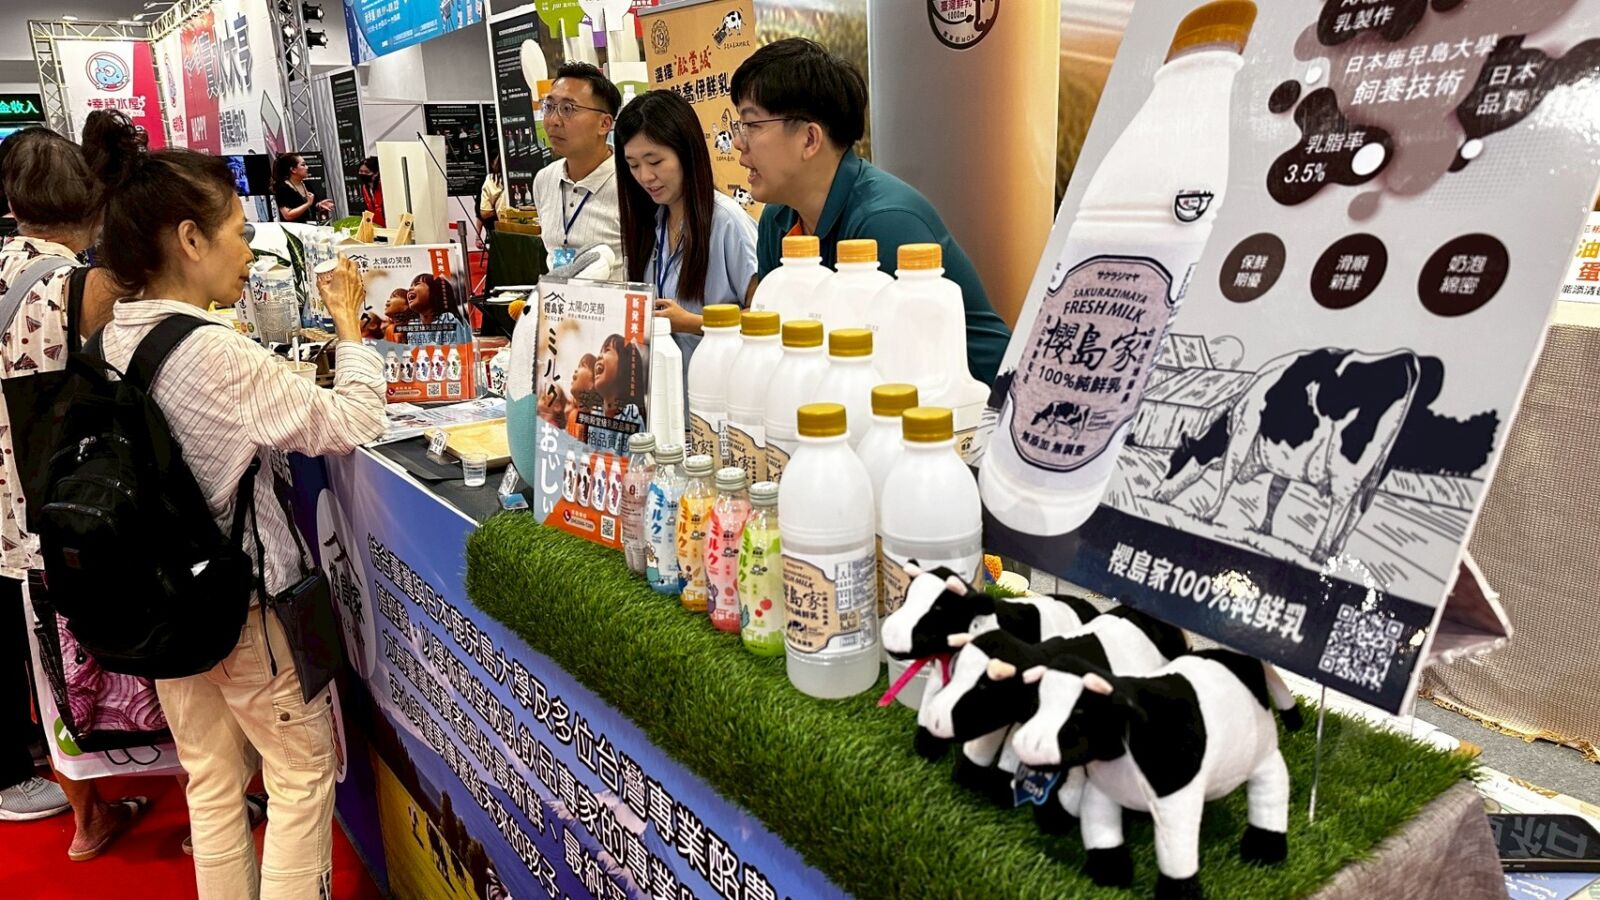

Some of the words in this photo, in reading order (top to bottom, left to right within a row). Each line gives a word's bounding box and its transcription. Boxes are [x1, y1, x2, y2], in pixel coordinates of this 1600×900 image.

[1333, 6, 1395, 33] 乳製作
[1345, 34, 1498, 74] 日本鹿兒島大學
[1490, 63, 1539, 86] 日本
[1351, 70, 1466, 105] 飼養技術
[1476, 93, 1529, 115] 品質
[1305, 131, 1366, 154] 乳脂率
[1284, 163, 1326, 184] 3.5%
[1241, 255, 1268, 271] 保鮮
[1336, 255, 1369, 271] 滑順
[1447, 255, 1487, 273] 奶泡
[1098, 271, 1140, 282] サクラジマヤ
[1328, 273, 1363, 290] 新鮮
[1439, 276, 1480, 295] 綿密
[1073, 287, 1148, 304] SAKURAZIMAYA
[1063, 300, 1107, 315] FRESH
[1106, 301, 1147, 323] MILK
[1044, 316, 1147, 372] 櫻島家
[1039, 365, 1121, 394] 100%純鮮乳
[651, 491, 665, 534] ミルク
[678, 505, 689, 548] ミルク
[707, 519, 720, 566] ミルク
[738, 532, 750, 582] ミルク
[1107, 542, 1307, 643] 櫻島家100%純鮮乳
